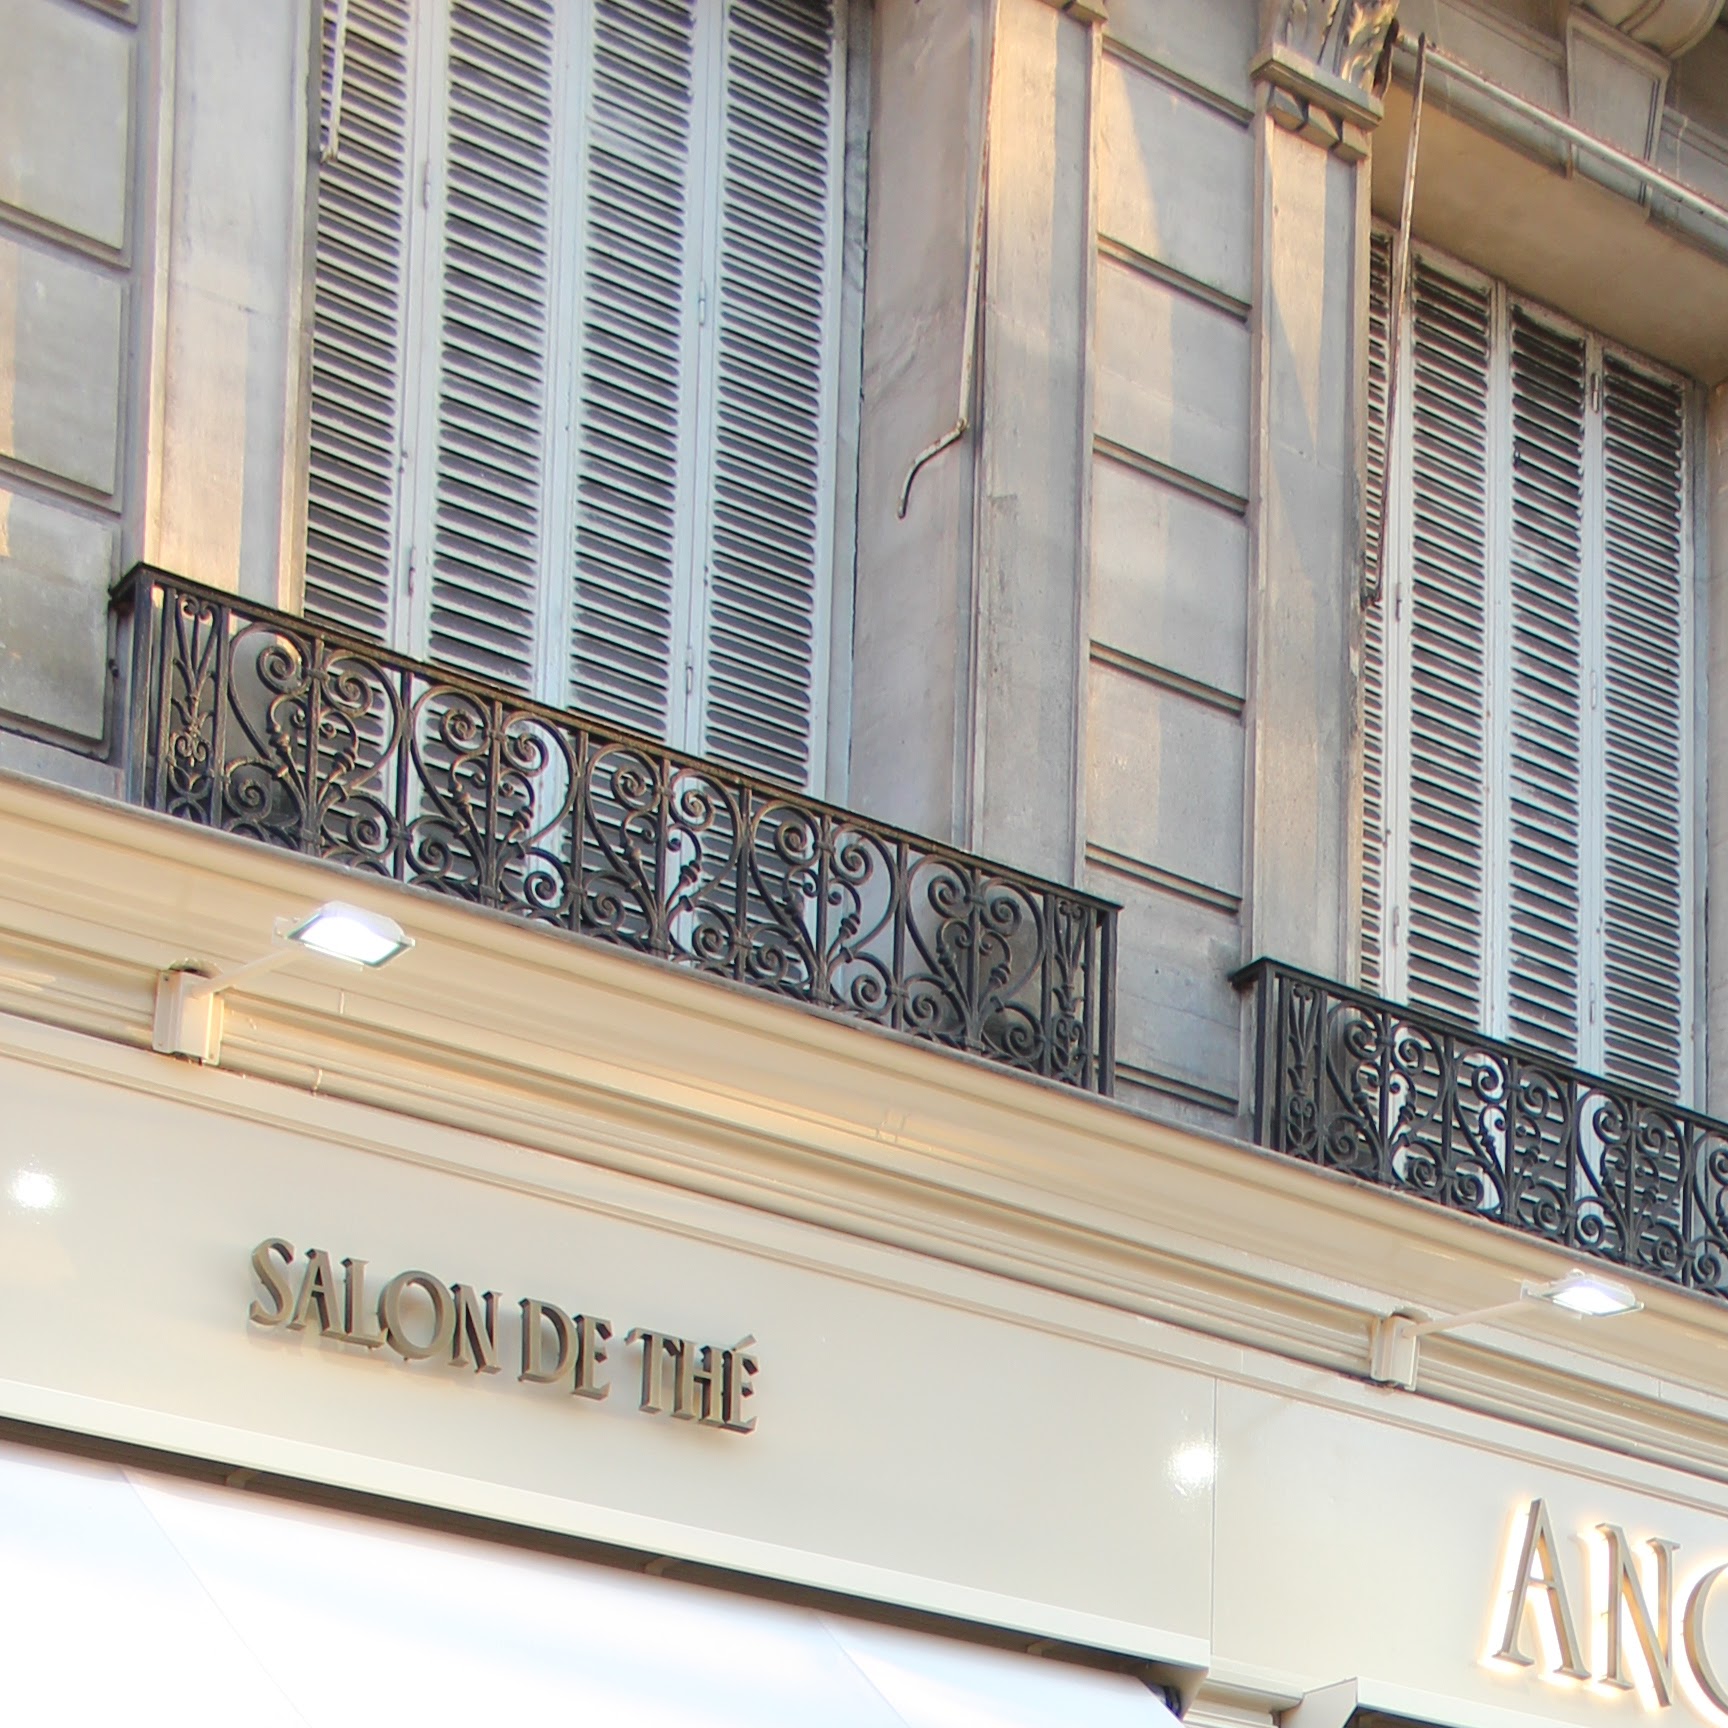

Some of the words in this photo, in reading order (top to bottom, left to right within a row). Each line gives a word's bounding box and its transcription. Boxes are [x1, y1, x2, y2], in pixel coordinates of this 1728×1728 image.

[248, 1237, 503, 1374] SALON
[517, 1297, 613, 1400] DE
[625, 1327, 758, 1434] THÉ
